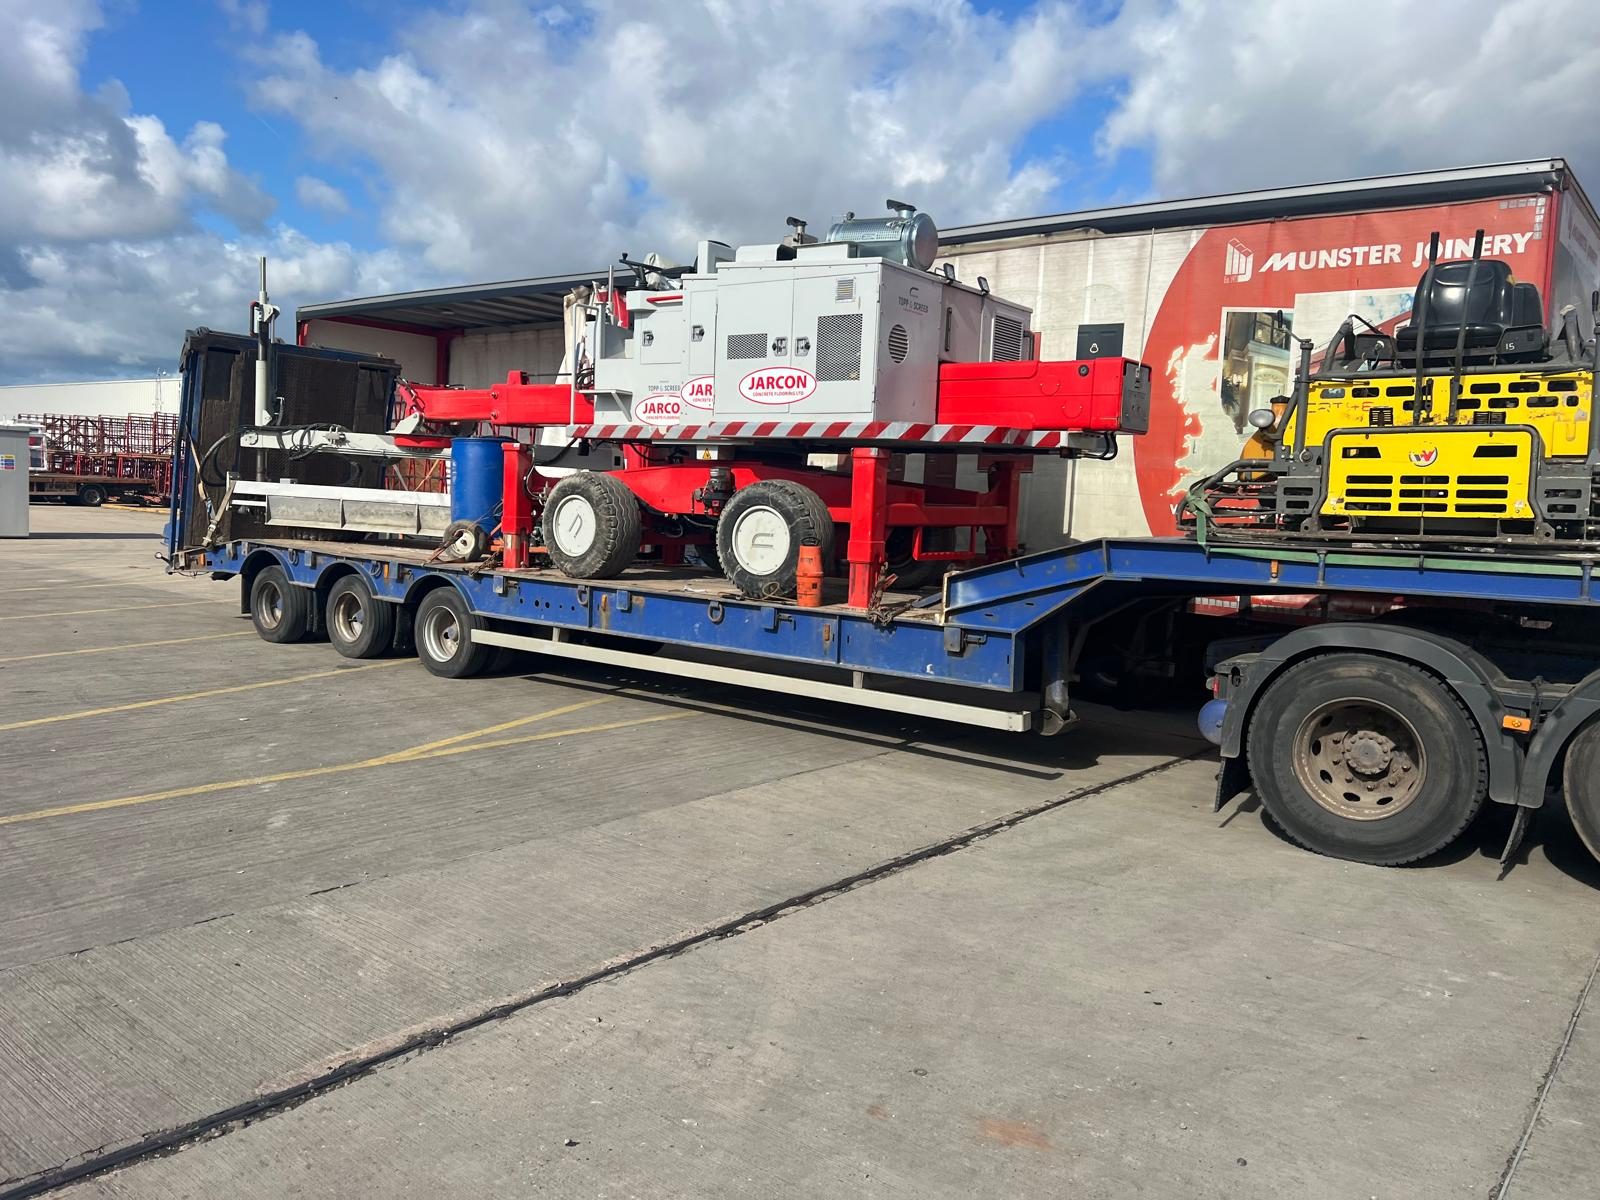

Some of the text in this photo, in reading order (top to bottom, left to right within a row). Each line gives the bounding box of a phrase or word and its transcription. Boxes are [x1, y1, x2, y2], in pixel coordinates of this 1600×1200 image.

[1258, 243, 1402, 273] MUNSTER
[1411, 231, 1534, 269] JOINERY
[1505, 342, 1515, 351] 15
[748, 375, 807, 390] JARCON
